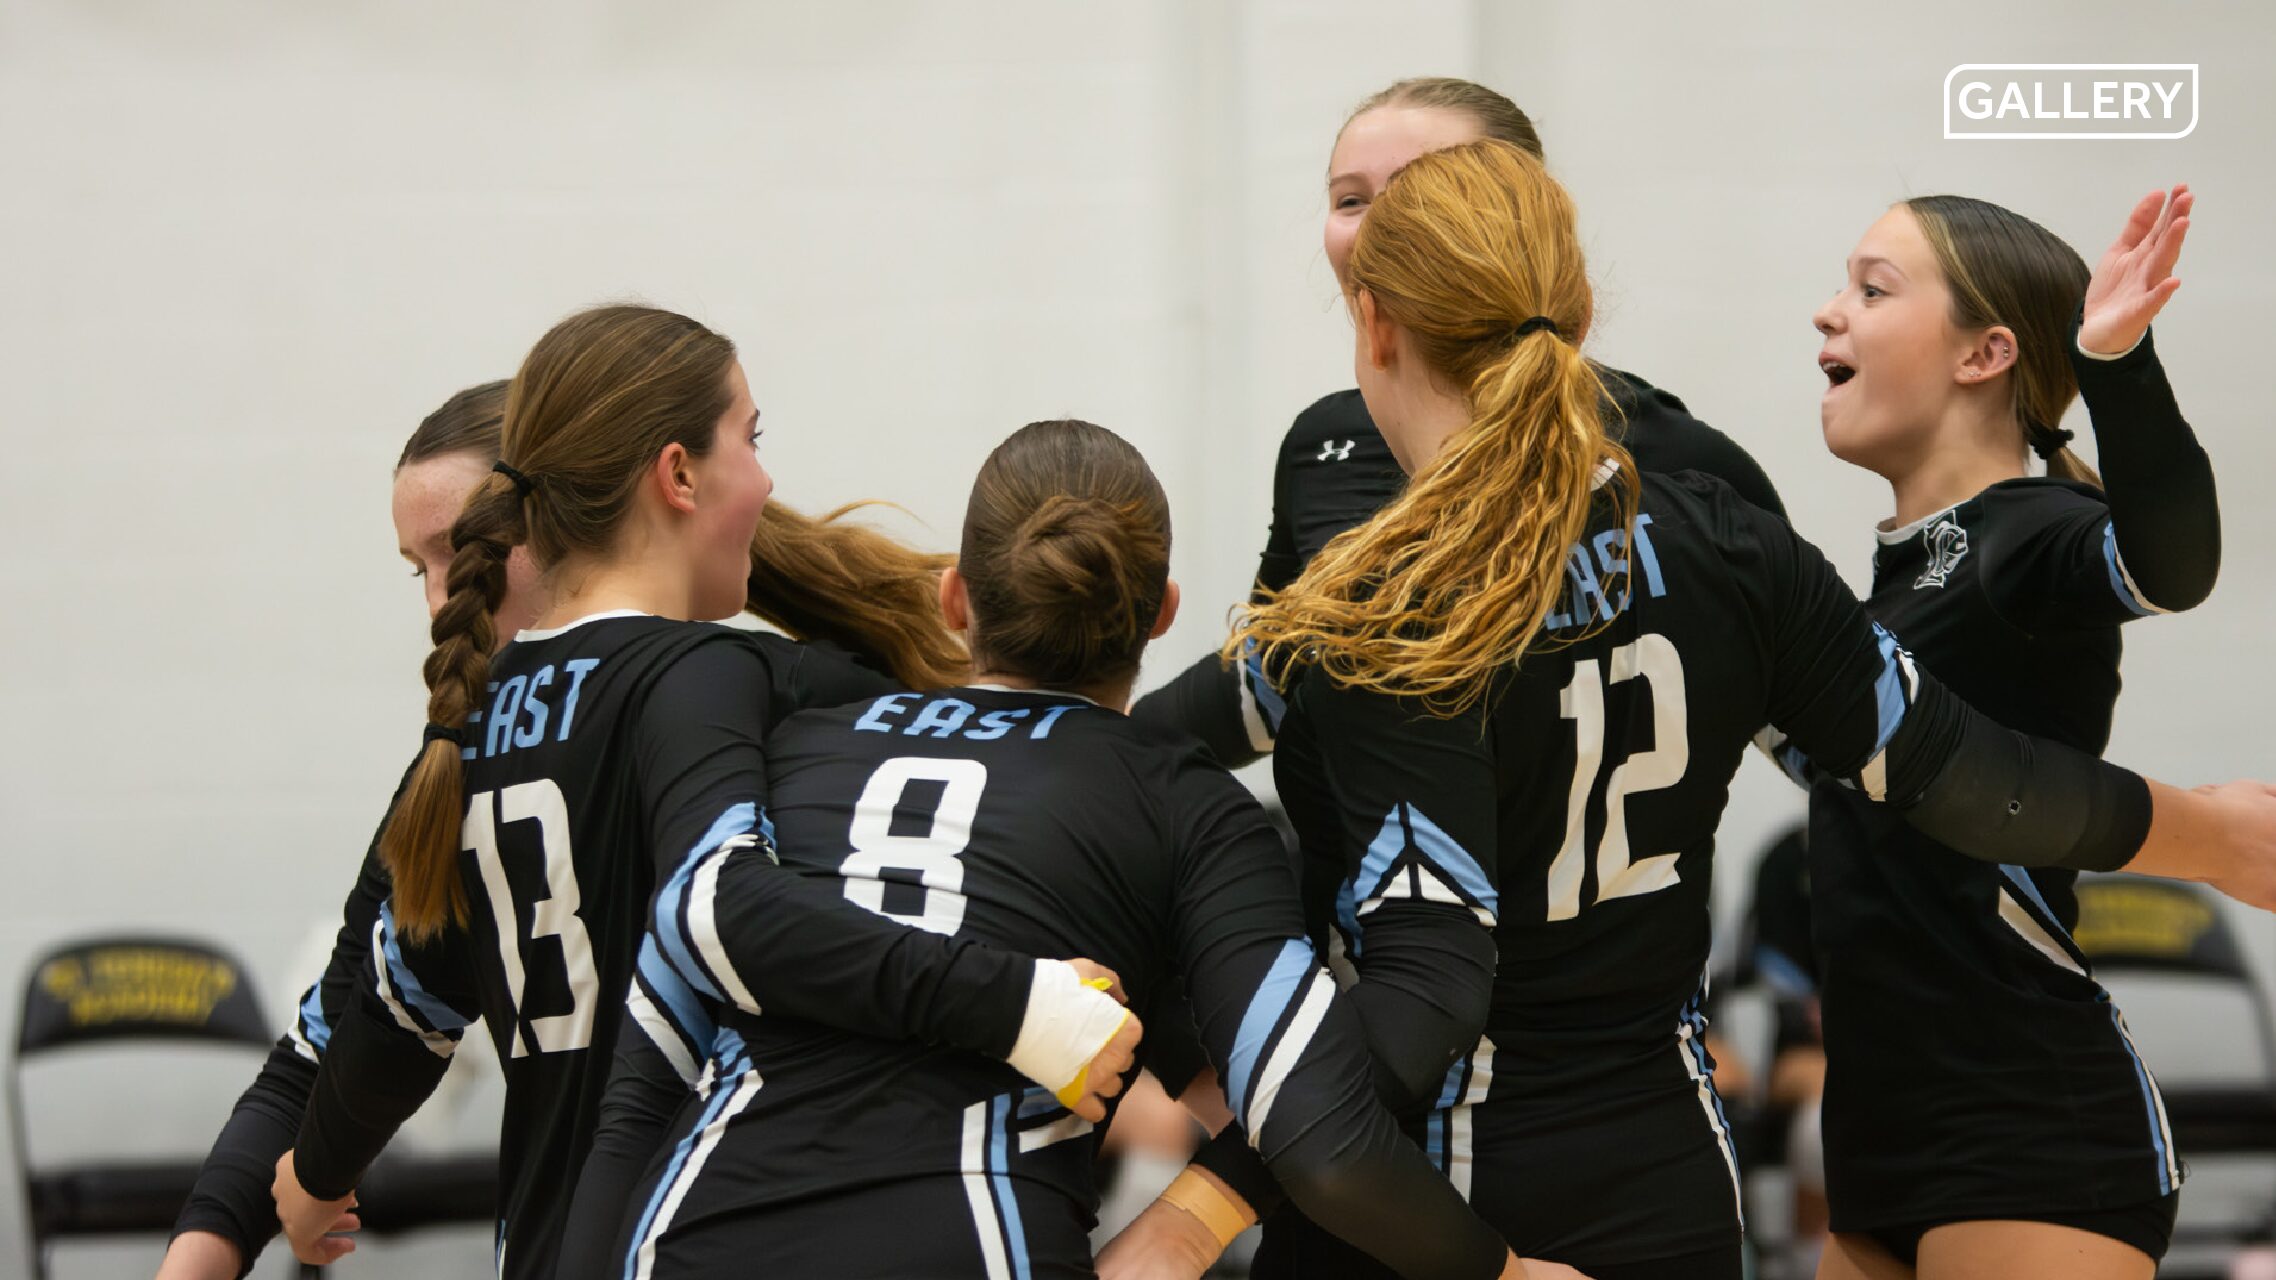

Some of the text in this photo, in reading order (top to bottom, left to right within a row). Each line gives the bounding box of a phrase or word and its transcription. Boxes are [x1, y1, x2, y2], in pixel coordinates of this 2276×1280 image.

[1545, 513, 1666, 630] AST
[854, 693, 1088, 740] EAST
[1547, 633, 1689, 922] 12
[461, 778, 600, 1059] 13
[838, 756, 988, 937] 8
